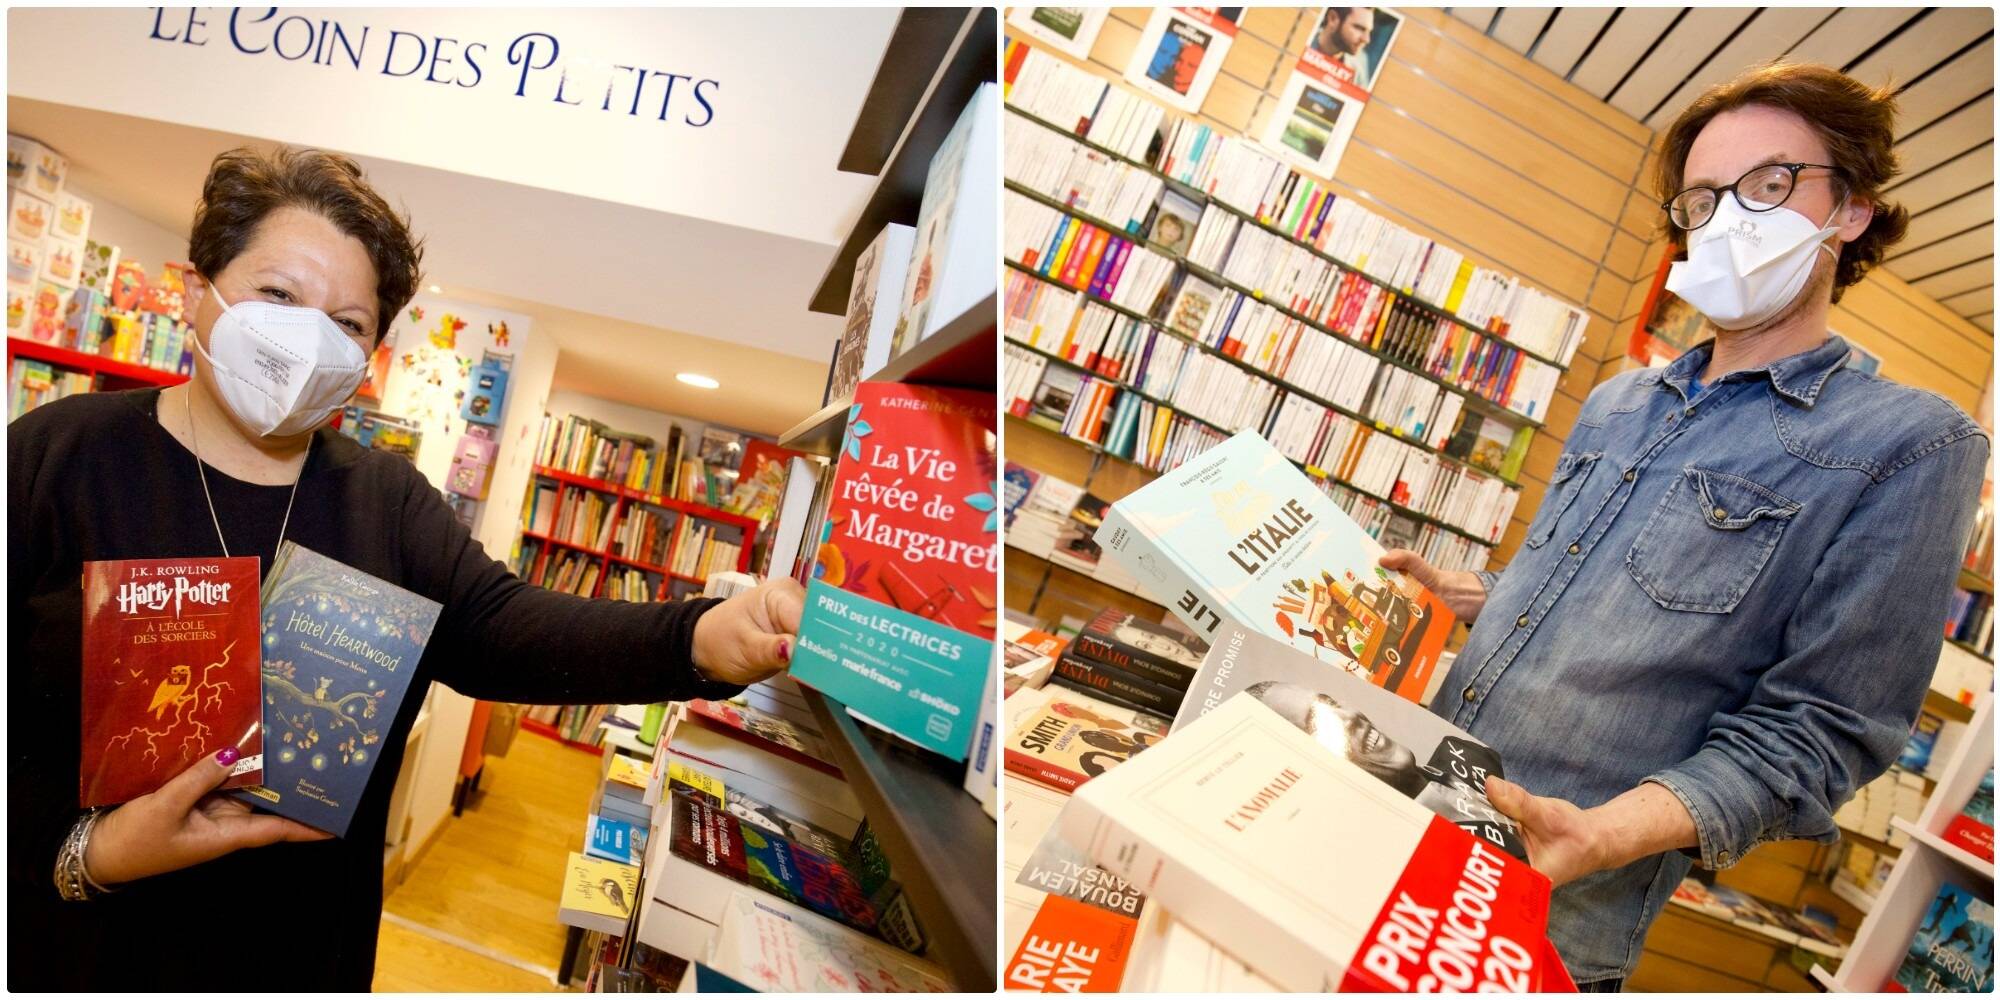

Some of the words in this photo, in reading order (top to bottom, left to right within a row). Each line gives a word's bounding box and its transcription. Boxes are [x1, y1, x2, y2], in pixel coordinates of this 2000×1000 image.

[149, 7, 210, 46] LE
[229, 7, 370, 71] COIN
[381, 30, 488, 88] DES
[1728, 226, 1762, 244] PRISM
[880, 397, 955, 414] KATHERINE
[870, 445, 900, 470] La
[904, 446, 957, 482] Vie
[842, 472, 919, 512] rêvée
[923, 494, 955, 521] de
[845, 509, 997, 573] Margaret
[1227, 498, 1314, 576] L'ITALIE
[131, 567, 153, 579] J.K.
[157, 565, 220, 576] ROWLING
[116, 581, 174, 614] Harry
[174, 576, 232, 620] Potter
[134, 634, 157, 645] DES
[161, 630, 217, 643] SORCIERS
[159, 620, 206, 632] L'ÉCOLE
[285, 610, 329, 639] Hôtel
[818, 595, 849, 618] PRIX
[849, 611, 869, 626] DES
[870, 615, 963, 660] LECTRICES
[807, 640, 838, 662] Babelio
[1080, 638, 1130, 668] DIVINE
[1214, 631, 1246, 688] PROMISE
[1060, 660, 1111, 689] DIVINE
[1020, 716, 1068, 754] SMITH
[235, 759, 251, 768] OLIO
[1041, 770, 1060, 782] SMITH
[1059, 776, 1076, 787] ZADIE
[1224, 768, 1304, 832] L'ANOMALIE
[691, 819, 702, 845] romans
[704, 824, 719, 866] bouleversés
[718, 830, 732, 857] millions
[1028, 867, 1139, 914] BOUALEM
[1362, 891, 1440, 992] PRIX
[1927, 942, 1986, 992] PERRIN
